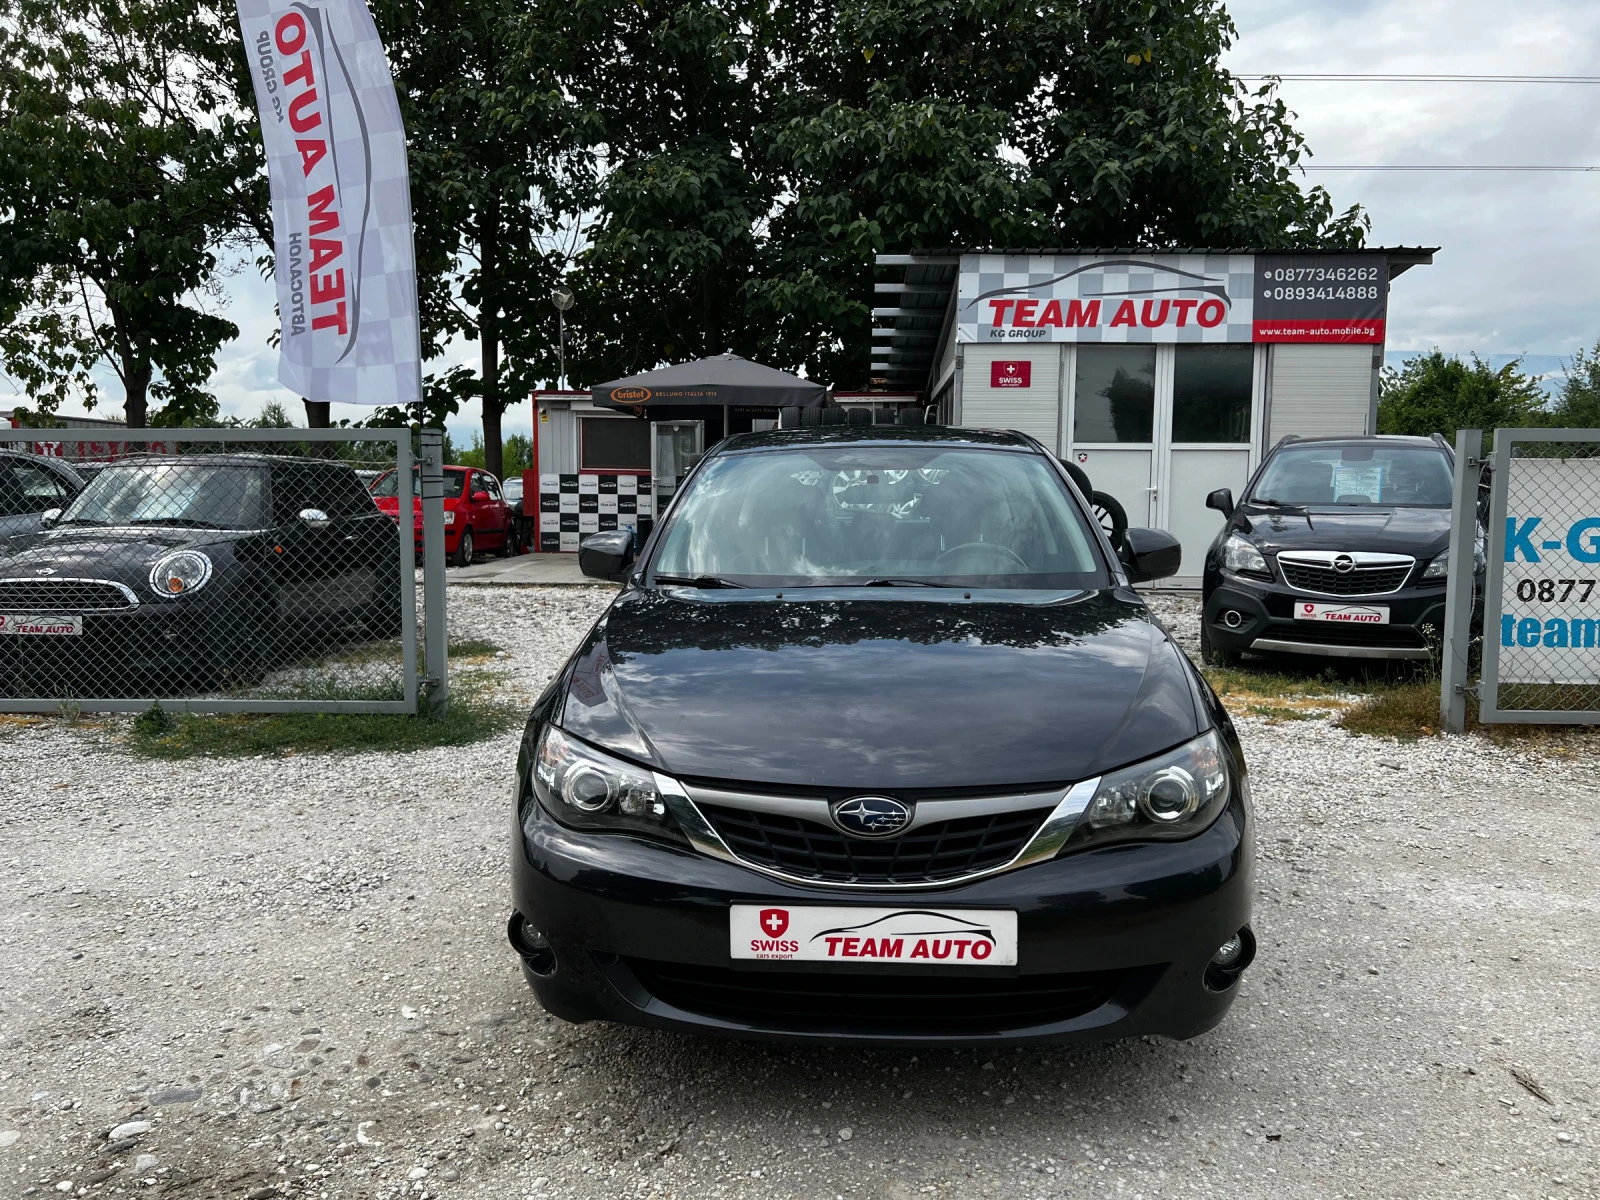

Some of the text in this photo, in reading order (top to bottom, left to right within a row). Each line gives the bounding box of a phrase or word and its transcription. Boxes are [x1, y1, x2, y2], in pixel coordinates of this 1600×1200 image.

[1274, 267, 1378, 281] 0877346262
[1273, 286, 1378, 300] 0893414888
[988, 299, 1226, 328] TEAM AUTO
[990, 329, 1046, 338] KG GROUP
[1259, 327, 1375, 337] www.team-auto.mobile.bg
[617, 388, 645, 399] bristot
[1516, 578, 1596, 602] 0877
[1325, 613, 1381, 622] TEAM AUTO
[16, 625, 43, 633] TEAM
[45, 625, 74, 634] AUTO
[750, 939, 799, 952] SWISS
[825, 937, 992, 960] TEAM AUTO
